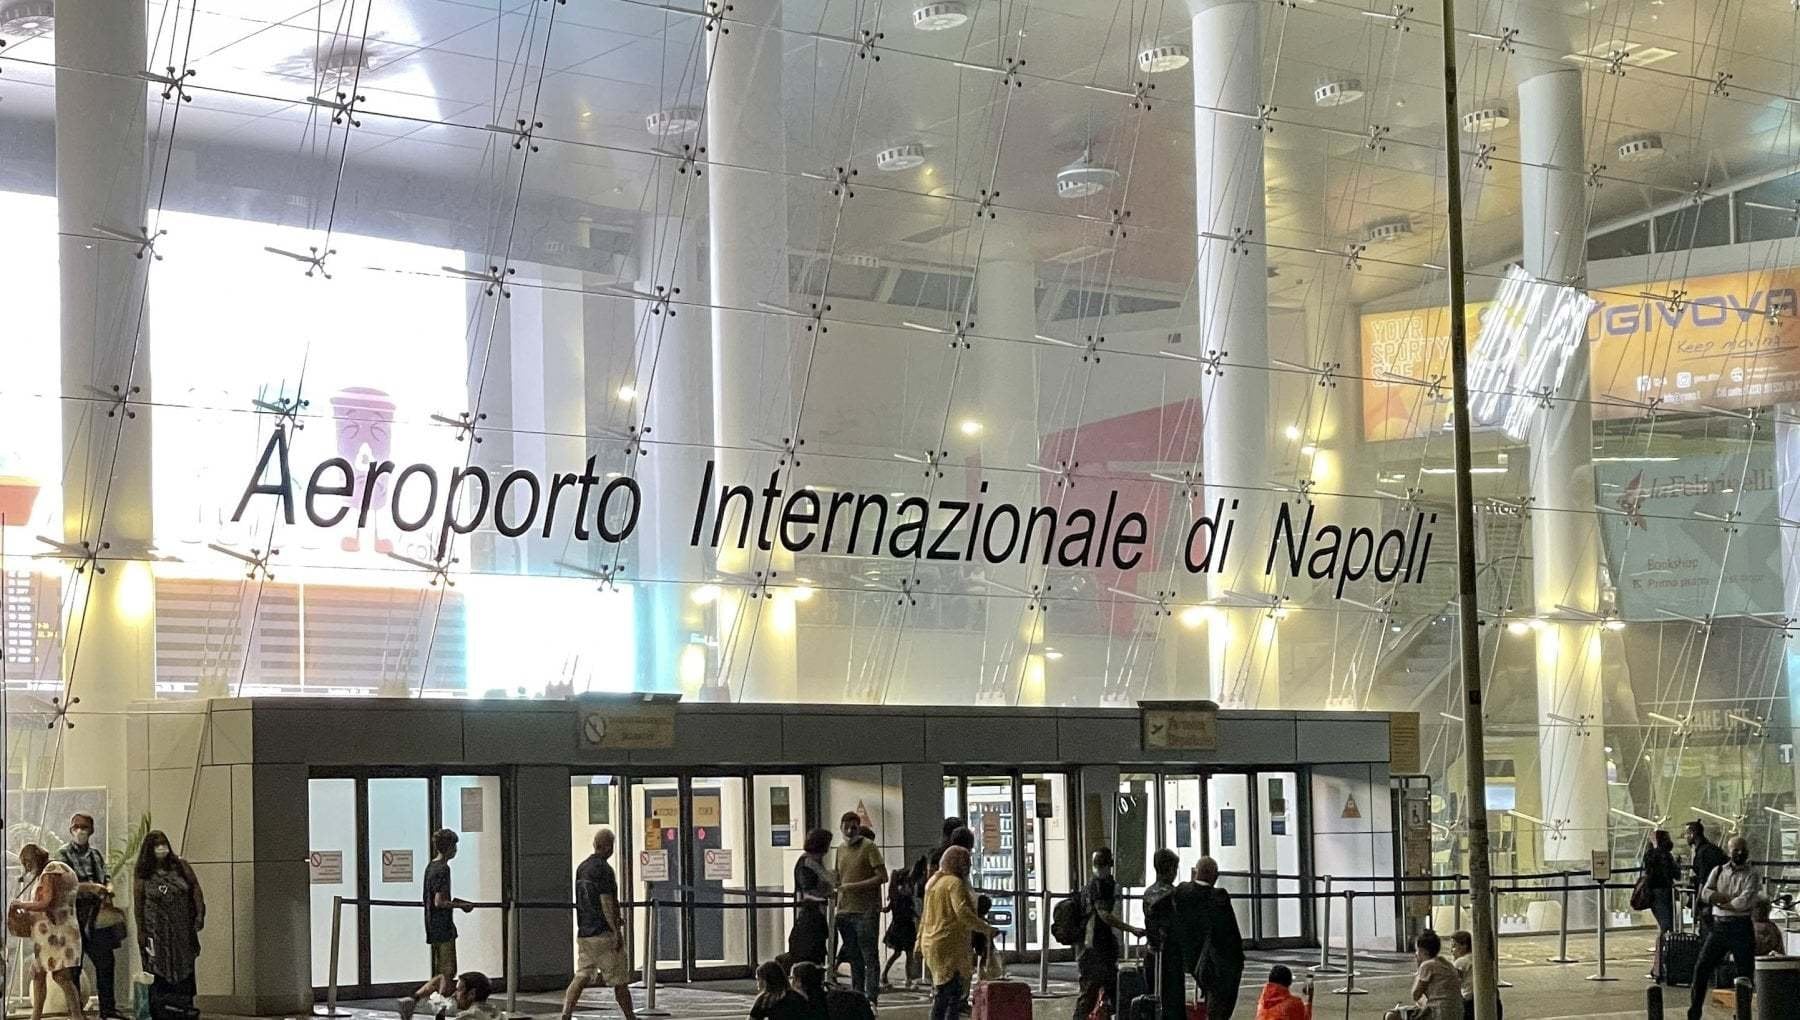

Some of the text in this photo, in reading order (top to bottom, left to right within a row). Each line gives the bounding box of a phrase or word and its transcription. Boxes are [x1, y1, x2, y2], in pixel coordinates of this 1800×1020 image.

[1372, 317, 1424, 341] YOUR
[1606, 288, 1798, 335] GIVOVA
[1372, 336, 1452, 364] SPORTY
[230, 423, 1438, 600] Aeroporto Internazionale di Napoli
